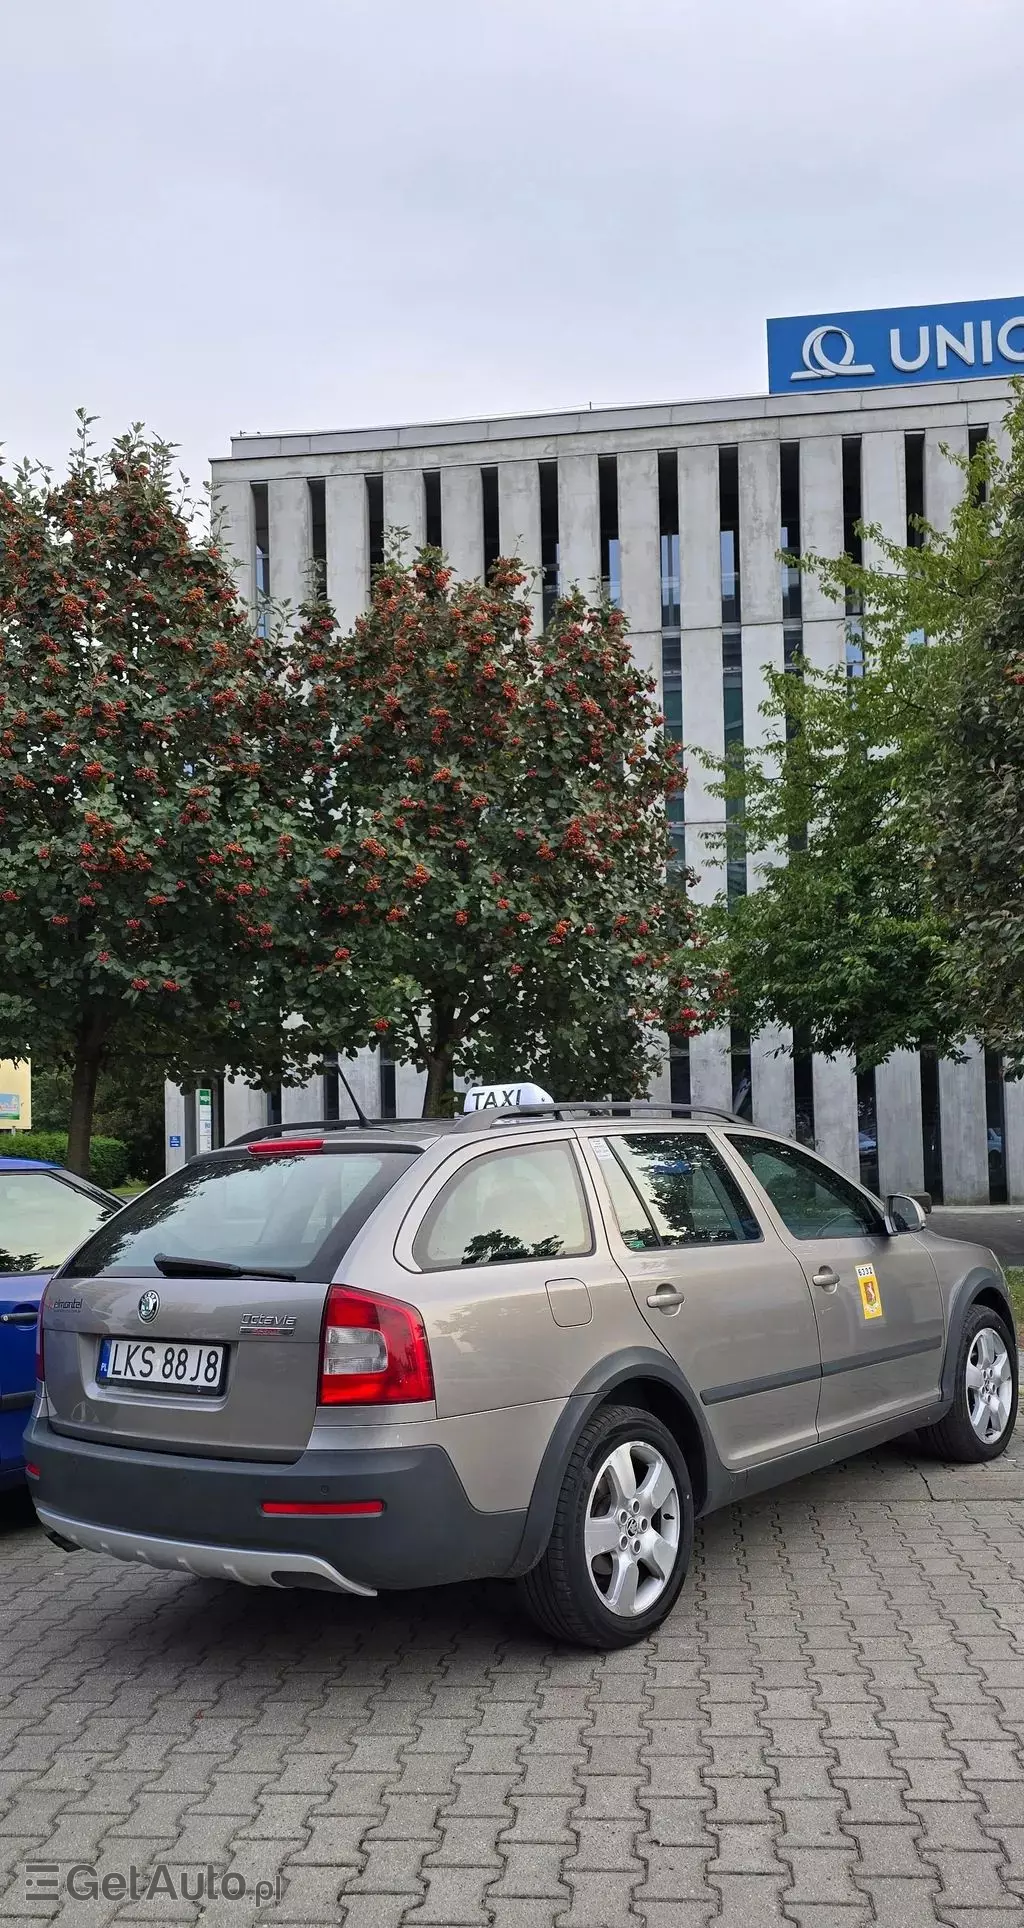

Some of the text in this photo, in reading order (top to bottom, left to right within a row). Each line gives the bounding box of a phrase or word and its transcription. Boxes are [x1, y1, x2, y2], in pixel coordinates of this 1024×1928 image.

[472, 1089, 521, 1110] TAXI
[100, 1362, 107, 1372] PL
[111, 1343, 219, 1383] LKS 88J8
